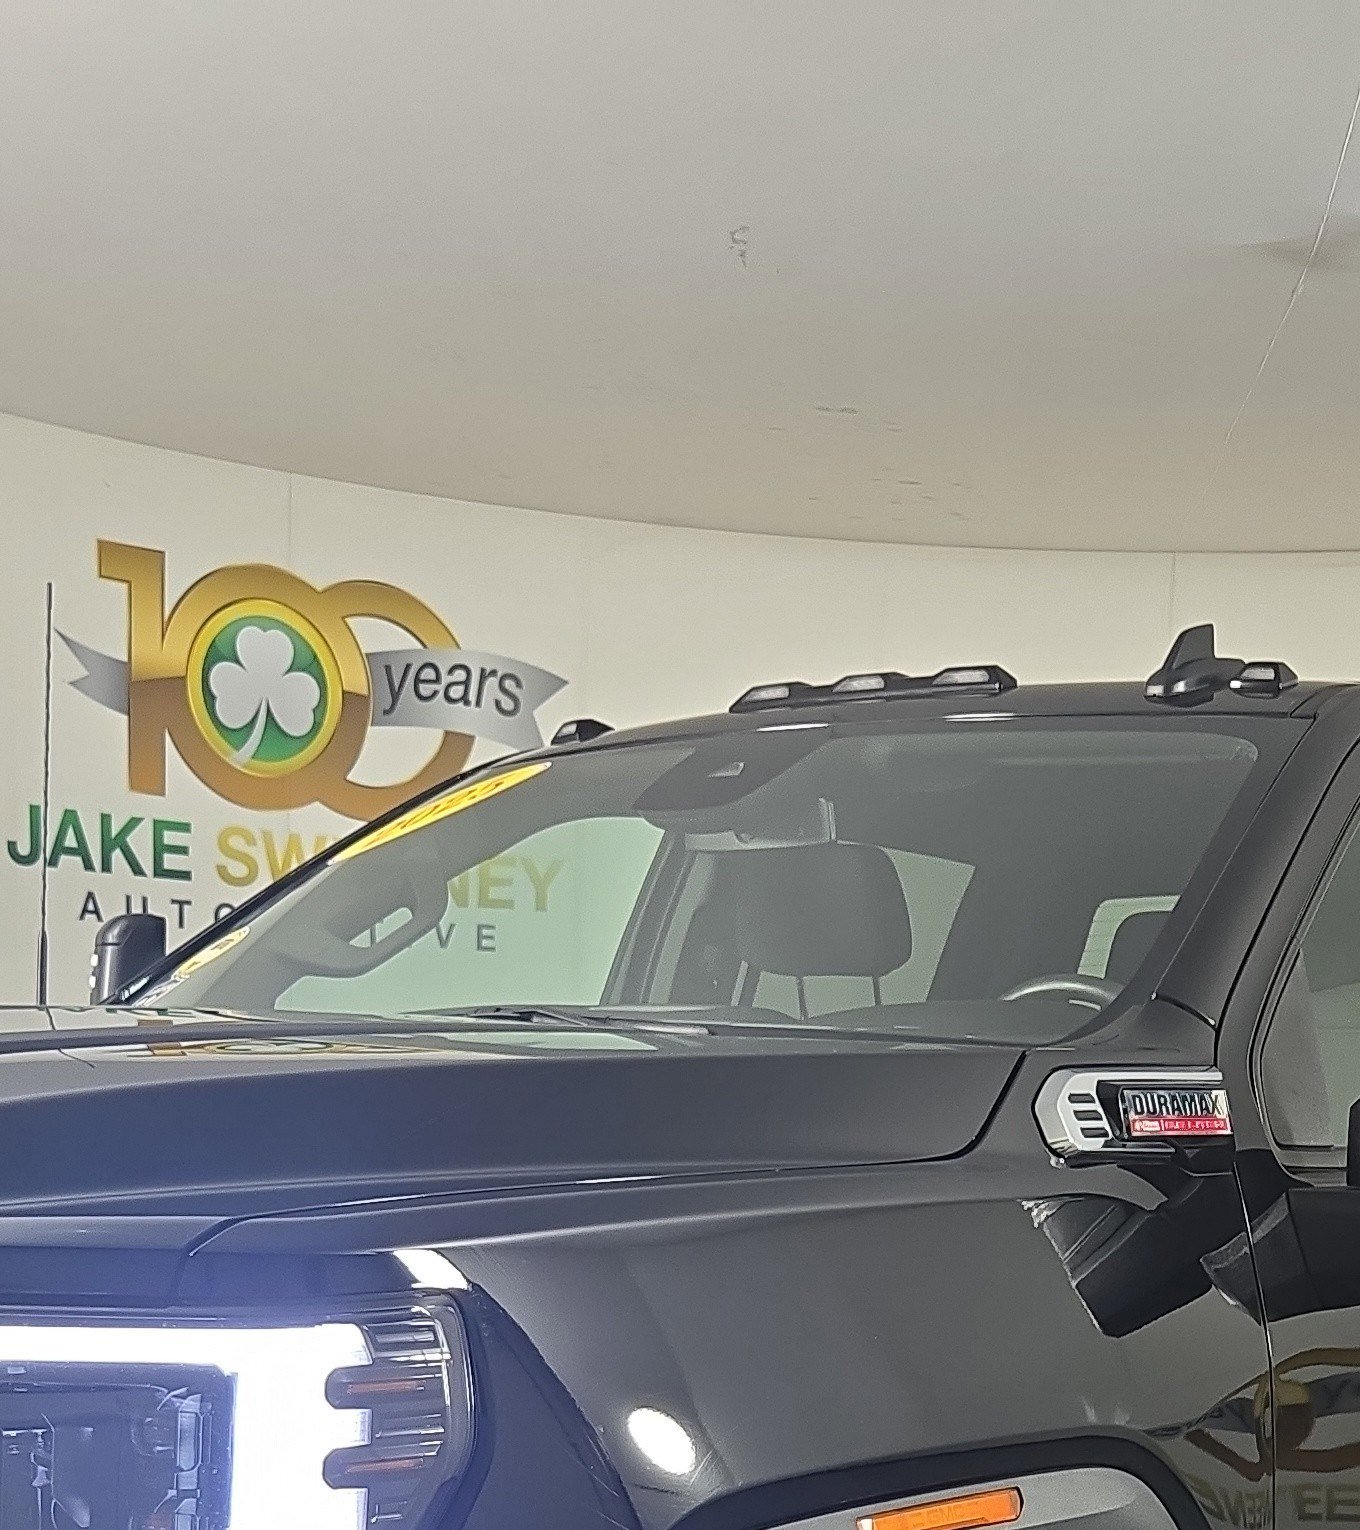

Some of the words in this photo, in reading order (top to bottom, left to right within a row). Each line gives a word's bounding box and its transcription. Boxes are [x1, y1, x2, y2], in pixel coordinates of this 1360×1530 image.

[97, 539, 476, 822] 100
[382, 659, 525, 717] years
[7, 804, 194, 883] JAKE
[215, 826, 565, 914] SWNEY
[1131, 1093, 1224, 1117] DURAMAX
